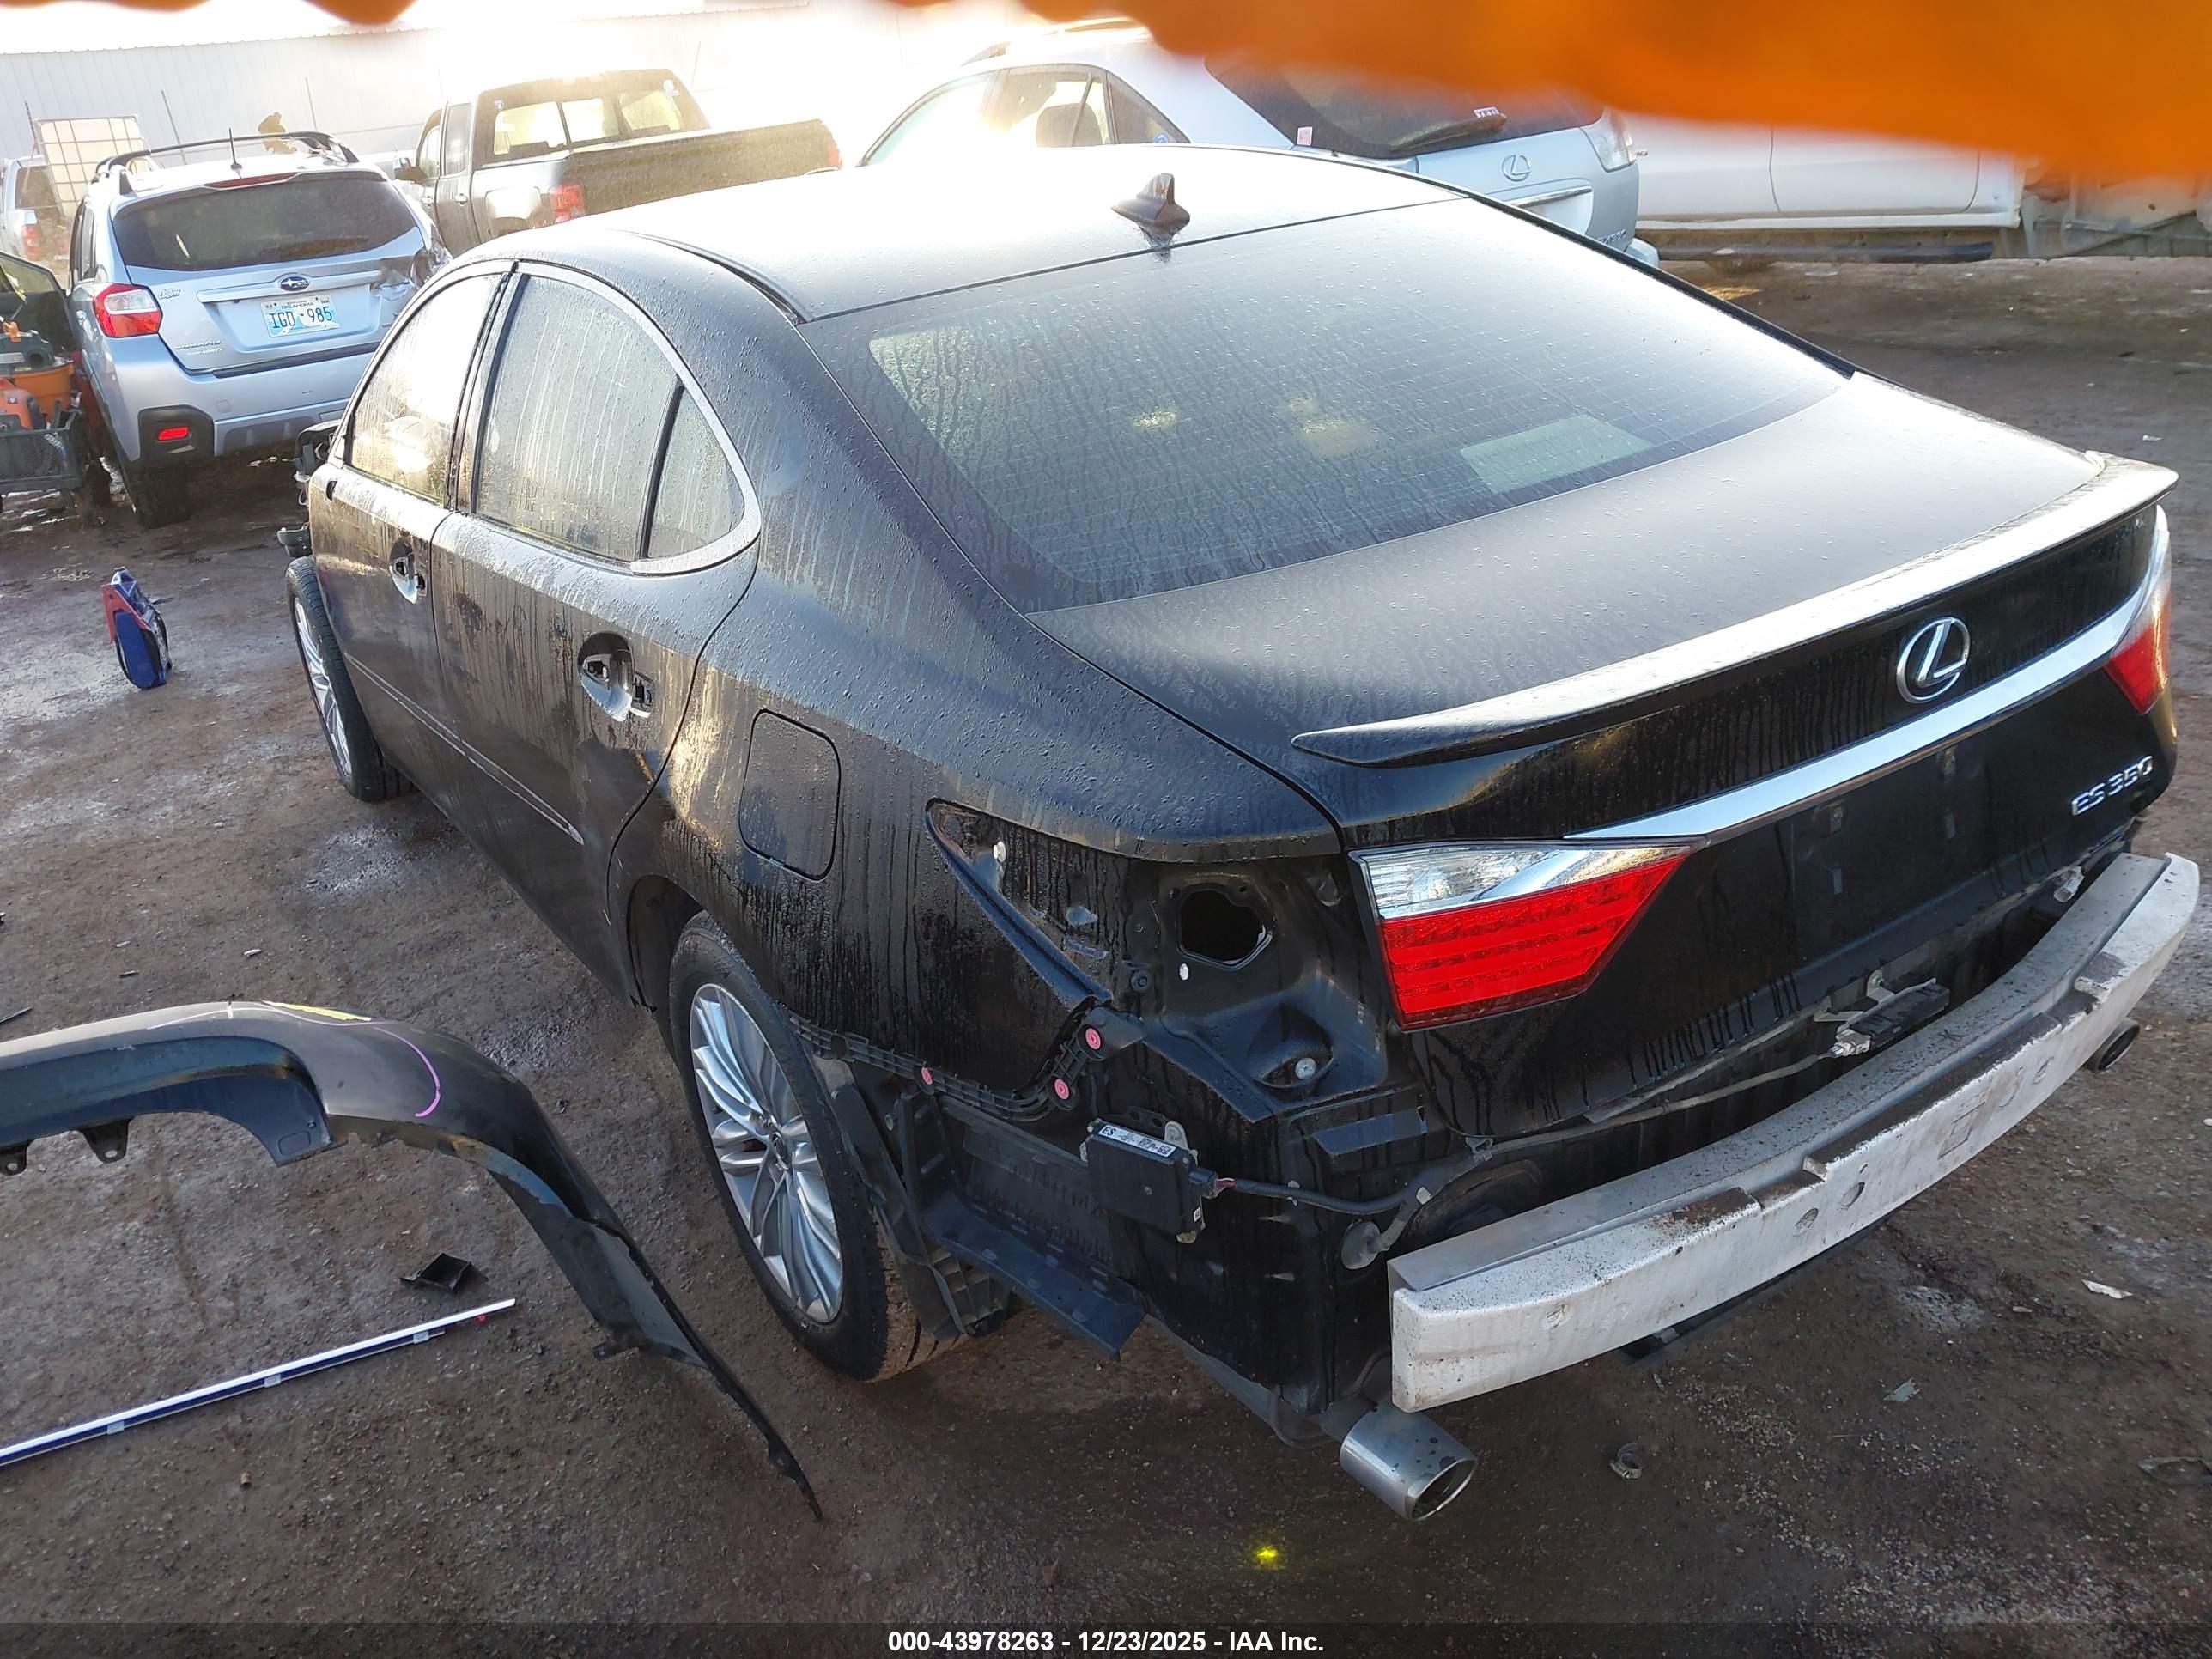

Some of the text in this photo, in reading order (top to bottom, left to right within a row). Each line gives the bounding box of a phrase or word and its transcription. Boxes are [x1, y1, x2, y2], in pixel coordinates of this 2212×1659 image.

[2071, 755, 2154, 817] ES 350
[1101, 1126, 1116, 1137] ES
